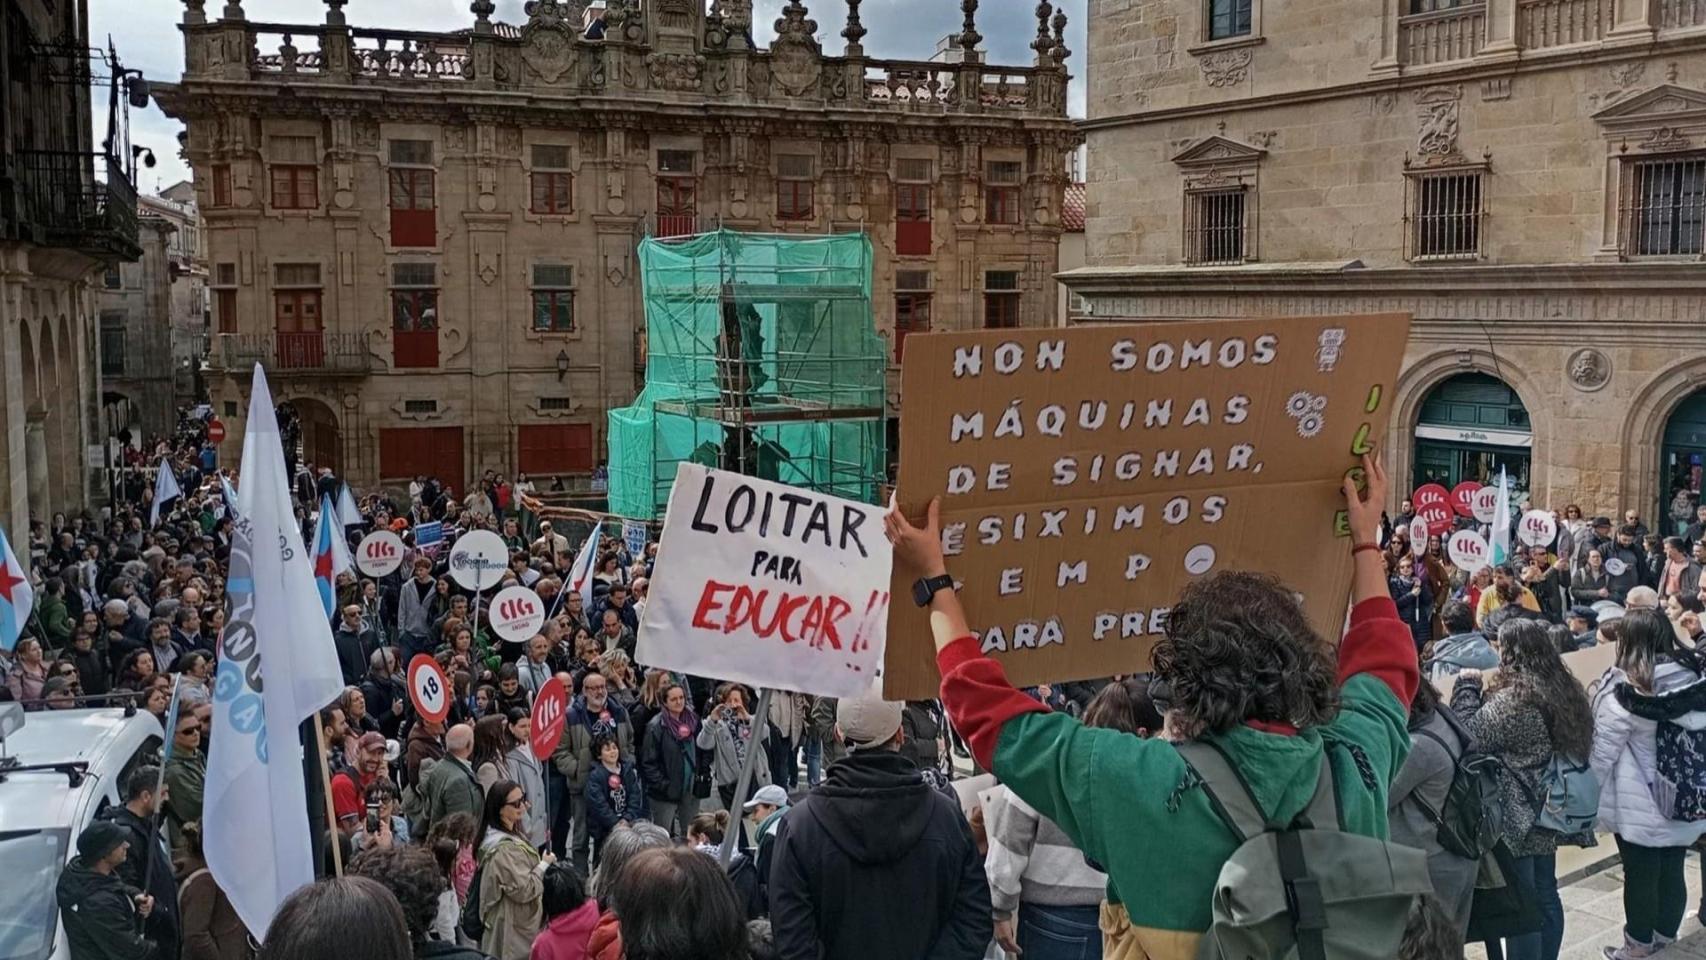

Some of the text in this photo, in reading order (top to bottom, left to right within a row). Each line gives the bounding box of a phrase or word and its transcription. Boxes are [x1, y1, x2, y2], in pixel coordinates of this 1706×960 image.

[953, 334, 1278, 378] NON SOMOS
[951, 394, 1251, 442] MÁQUINAS
[947, 443, 1265, 494] DE SIGNAR,
[691, 476, 868, 557] LOITAR
[941, 495, 1227, 556] ESIXIMOS
[1423, 508, 1447, 523] CIG
[366, 541, 395, 558] CIG
[1456, 538, 1482, 556] CIG
[751, 550, 802, 585] PARA
[499, 598, 534, 621] CIG
[973, 617, 1065, 655] ARA
[422, 676, 439, 701] 18
